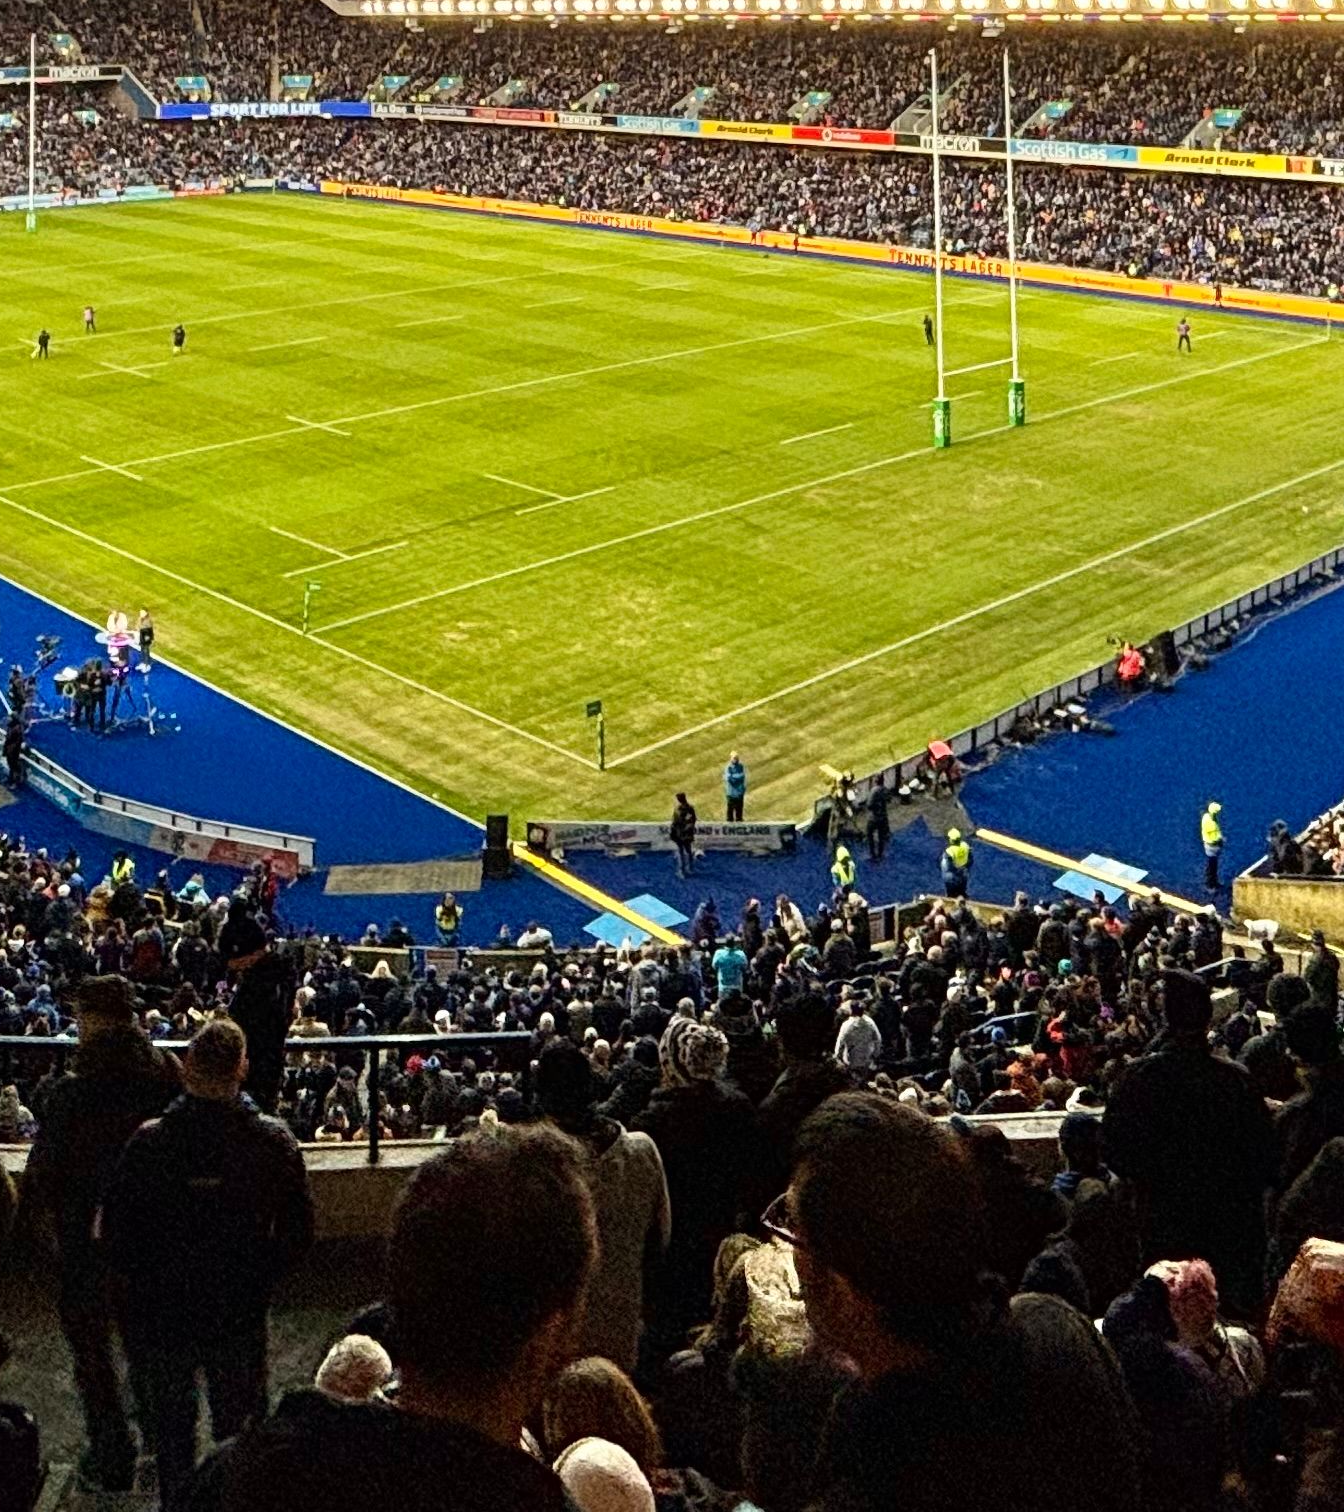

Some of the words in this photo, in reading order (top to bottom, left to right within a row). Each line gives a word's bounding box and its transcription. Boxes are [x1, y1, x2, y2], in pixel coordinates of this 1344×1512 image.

[49, 67, 100, 80] macron
[210, 102, 259, 117] SPORT
[260, 102, 289, 117] FOR
[291, 102, 320, 117] LIFE
[1016, 139, 1075, 159] Scottish
[1079, 145, 1107, 161] Gas
[1165, 153, 1213, 165] Arnold
[1217, 157, 1256, 169] Clark
[962, 260, 1003, 276] LAGER
